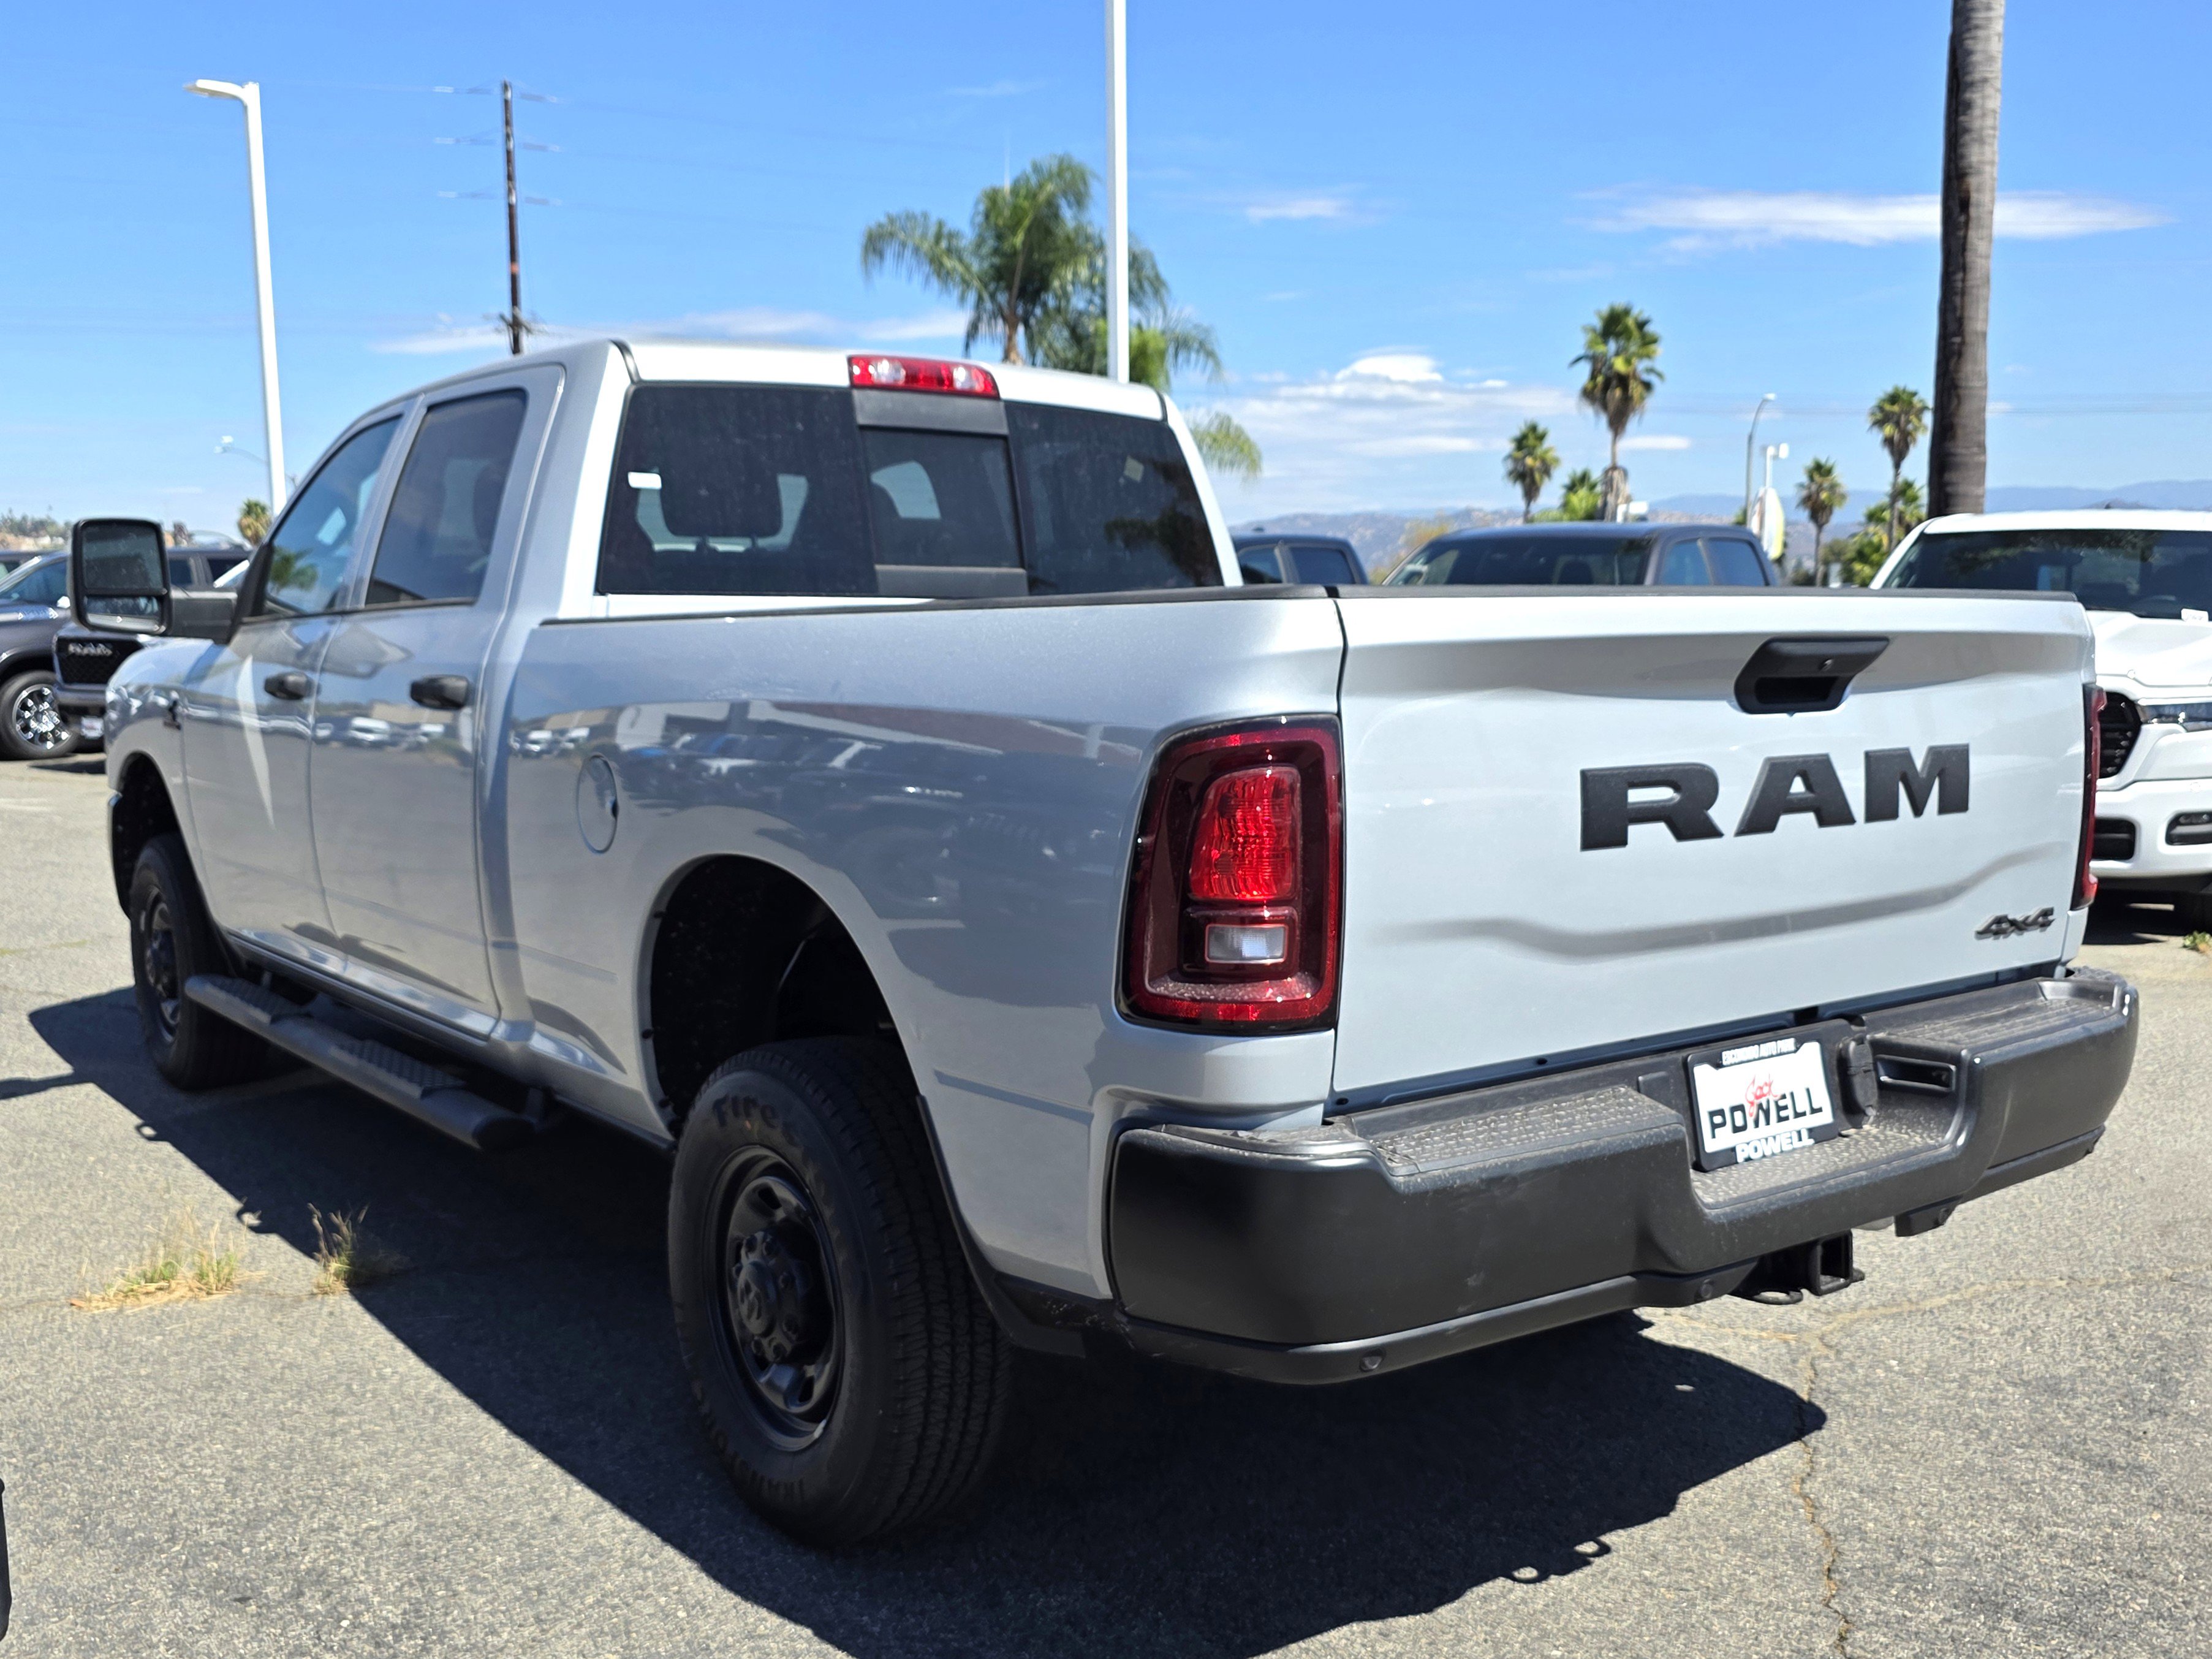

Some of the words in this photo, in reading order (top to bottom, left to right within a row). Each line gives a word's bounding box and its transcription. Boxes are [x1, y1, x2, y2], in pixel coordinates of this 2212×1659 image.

[1580, 743, 1970, 852] RAM
[1974, 906, 2056, 939] 4x4
[1708, 1087, 1823, 1139] POWELL
[1745, 1074, 1781, 1117] Jack
[1735, 1128, 1815, 1163] POWELL
